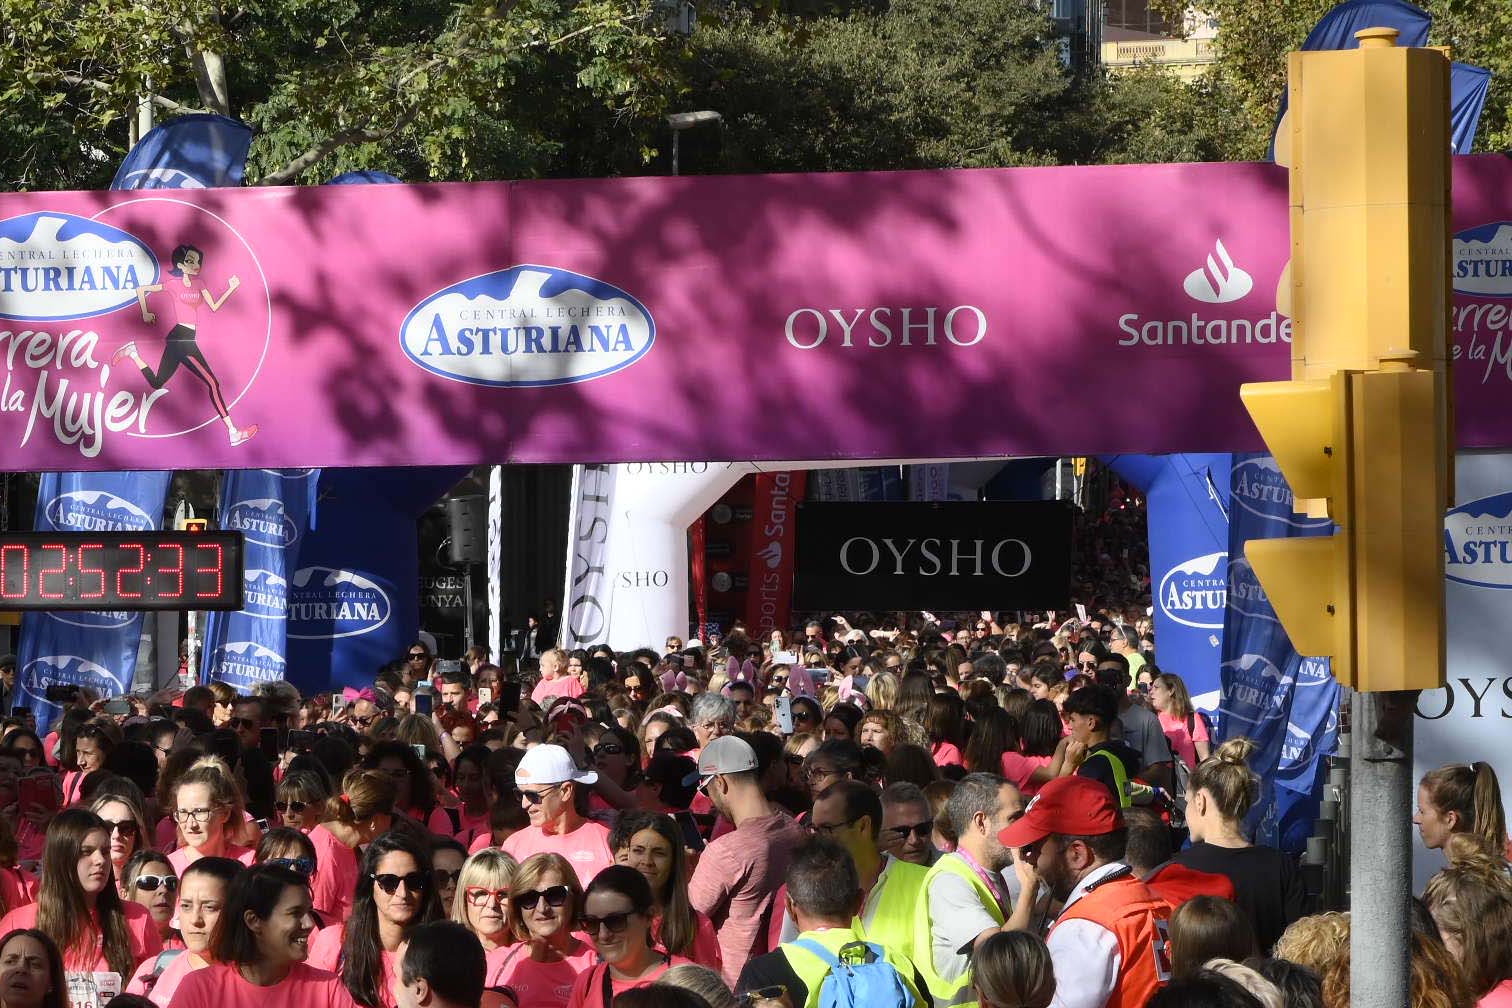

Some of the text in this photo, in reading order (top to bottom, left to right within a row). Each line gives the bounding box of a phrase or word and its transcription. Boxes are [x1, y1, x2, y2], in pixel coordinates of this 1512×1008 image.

[63, 249, 136, 260] LECHERA
[460, 305, 626, 320] CENTRAL LECHERA
[785, 305, 987, 349] OYSHO
[1118, 312, 1292, 346] Santande
[420, 313, 635, 357] ASTURIANA
[1468, 333, 1486, 360] la
[1, 373, 25, 412] la
[20, 365, 170, 458] Mujer
[764, 471, 791, 537] Santa
[1465, 525, 1512, 536] CENTR
[0, 543, 224, 599] 02:52:33
[569, 464, 612, 644] OYSH
[839, 536, 1032, 578] OYSHO
[621, 570, 670, 589] SHO
[1182, 579, 1225, 588] CENTRA
[287, 602, 382, 621] TURIANA
[1414, 677, 1512, 720] OYS
